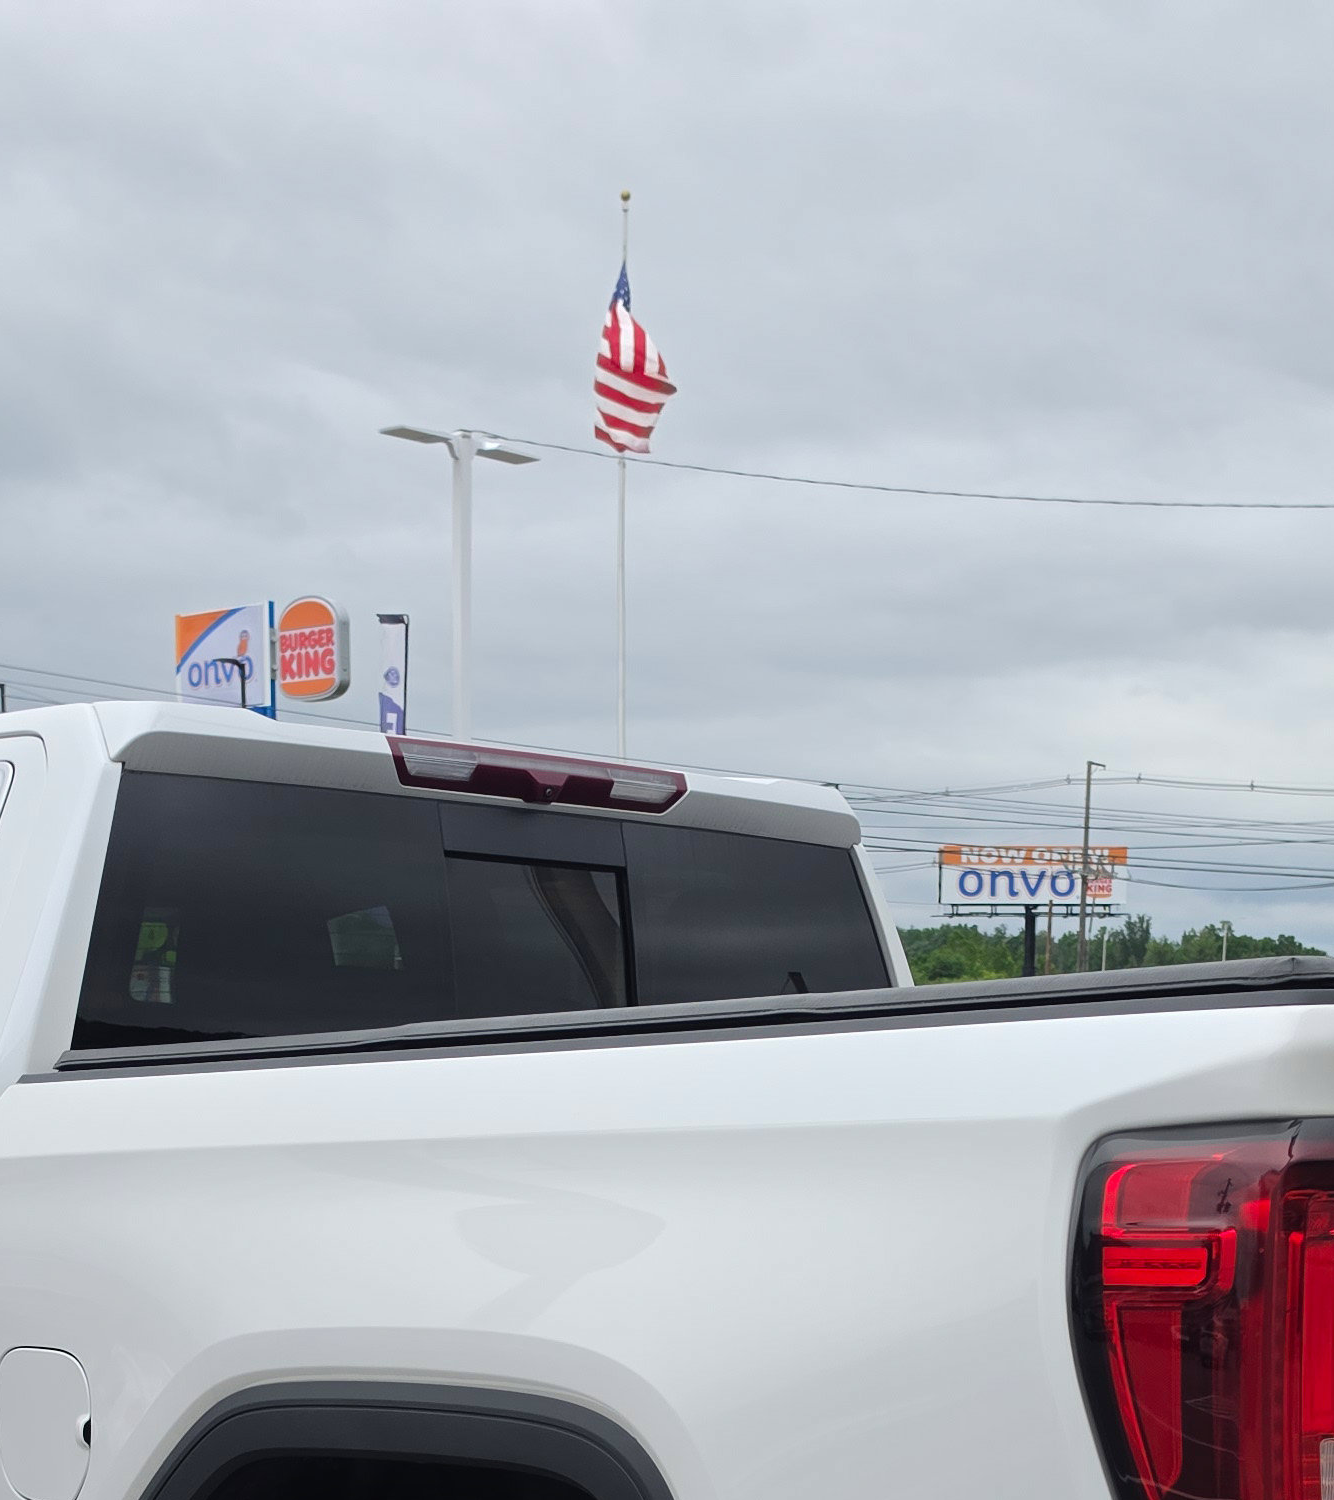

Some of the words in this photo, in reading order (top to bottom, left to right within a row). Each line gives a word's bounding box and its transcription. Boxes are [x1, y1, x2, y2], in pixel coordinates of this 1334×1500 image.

[280, 627, 334, 652] BURGER
[188, 656, 254, 687] onvo
[280, 649, 335, 681] KING
[960, 847, 1026, 864] NOW
[958, 870, 1075, 898] onvo
